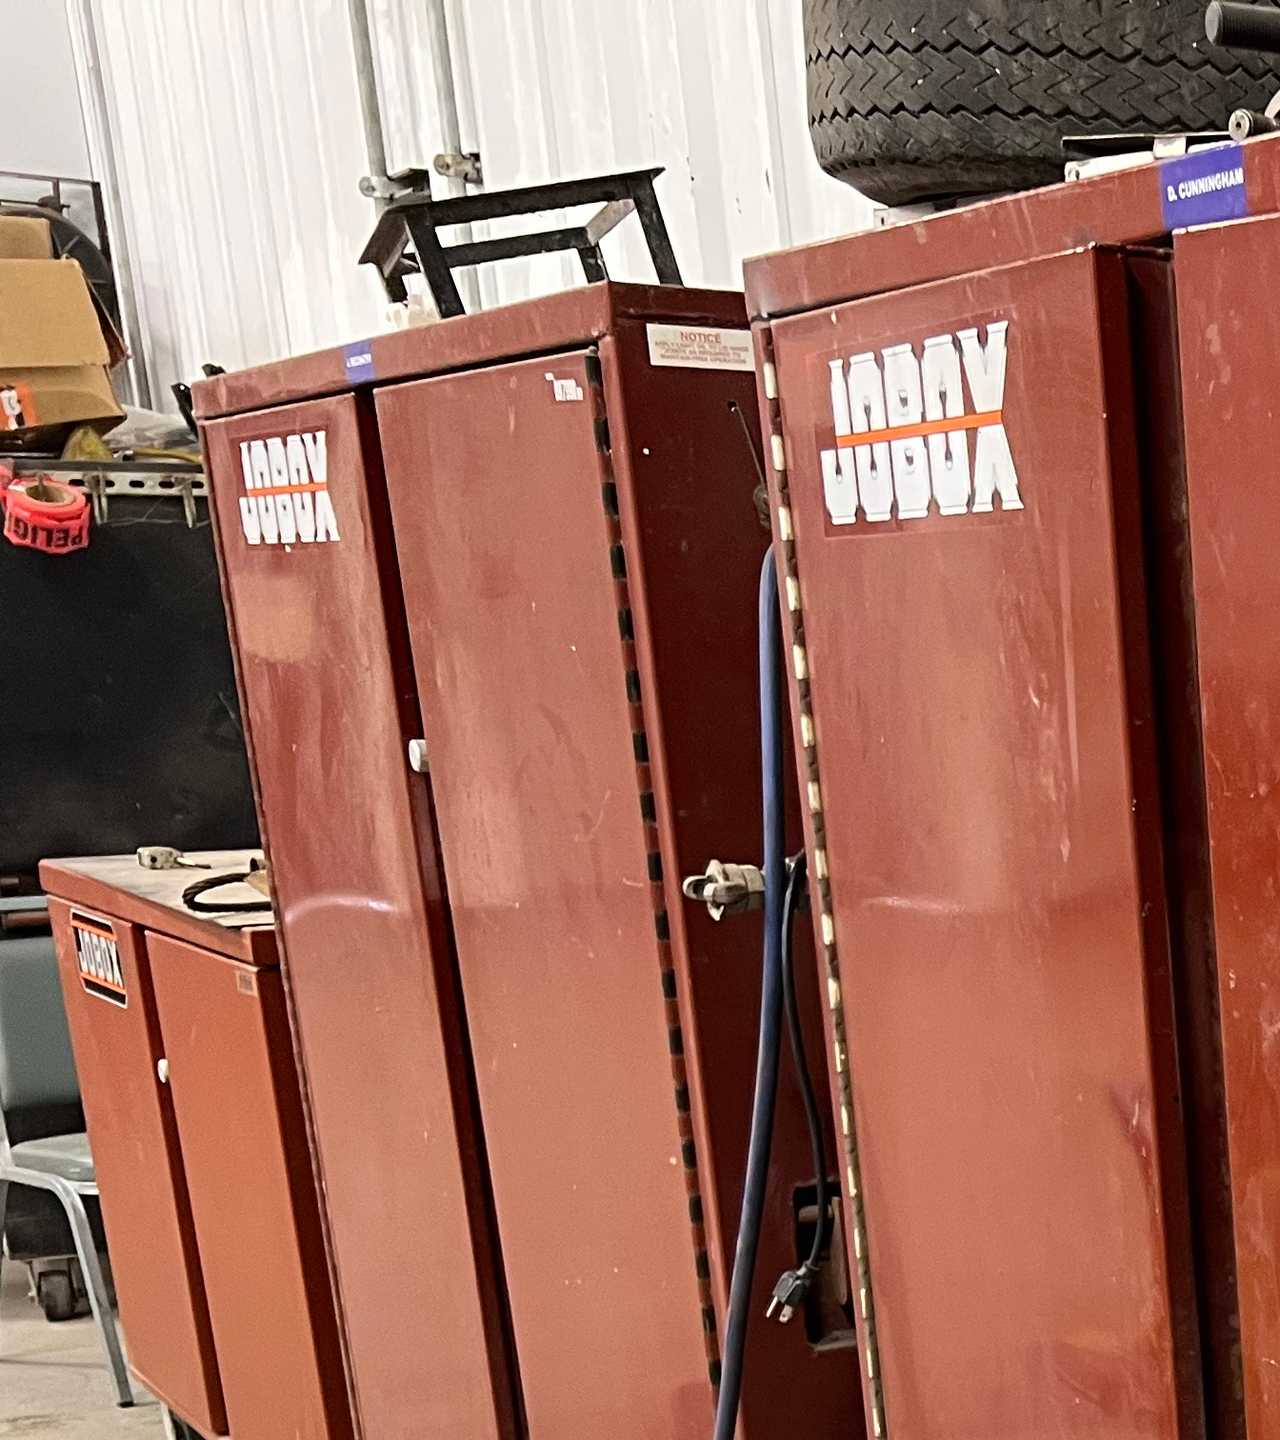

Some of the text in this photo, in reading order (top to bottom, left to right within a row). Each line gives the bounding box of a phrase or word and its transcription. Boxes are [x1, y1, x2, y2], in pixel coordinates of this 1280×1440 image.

[1178, 167, 1245, 200] CUNNINGHAM
[680, 331, 722, 344] NOTICE
[8, 512, 84, 548] PELIG
[77, 927, 125, 990] JOBOX
